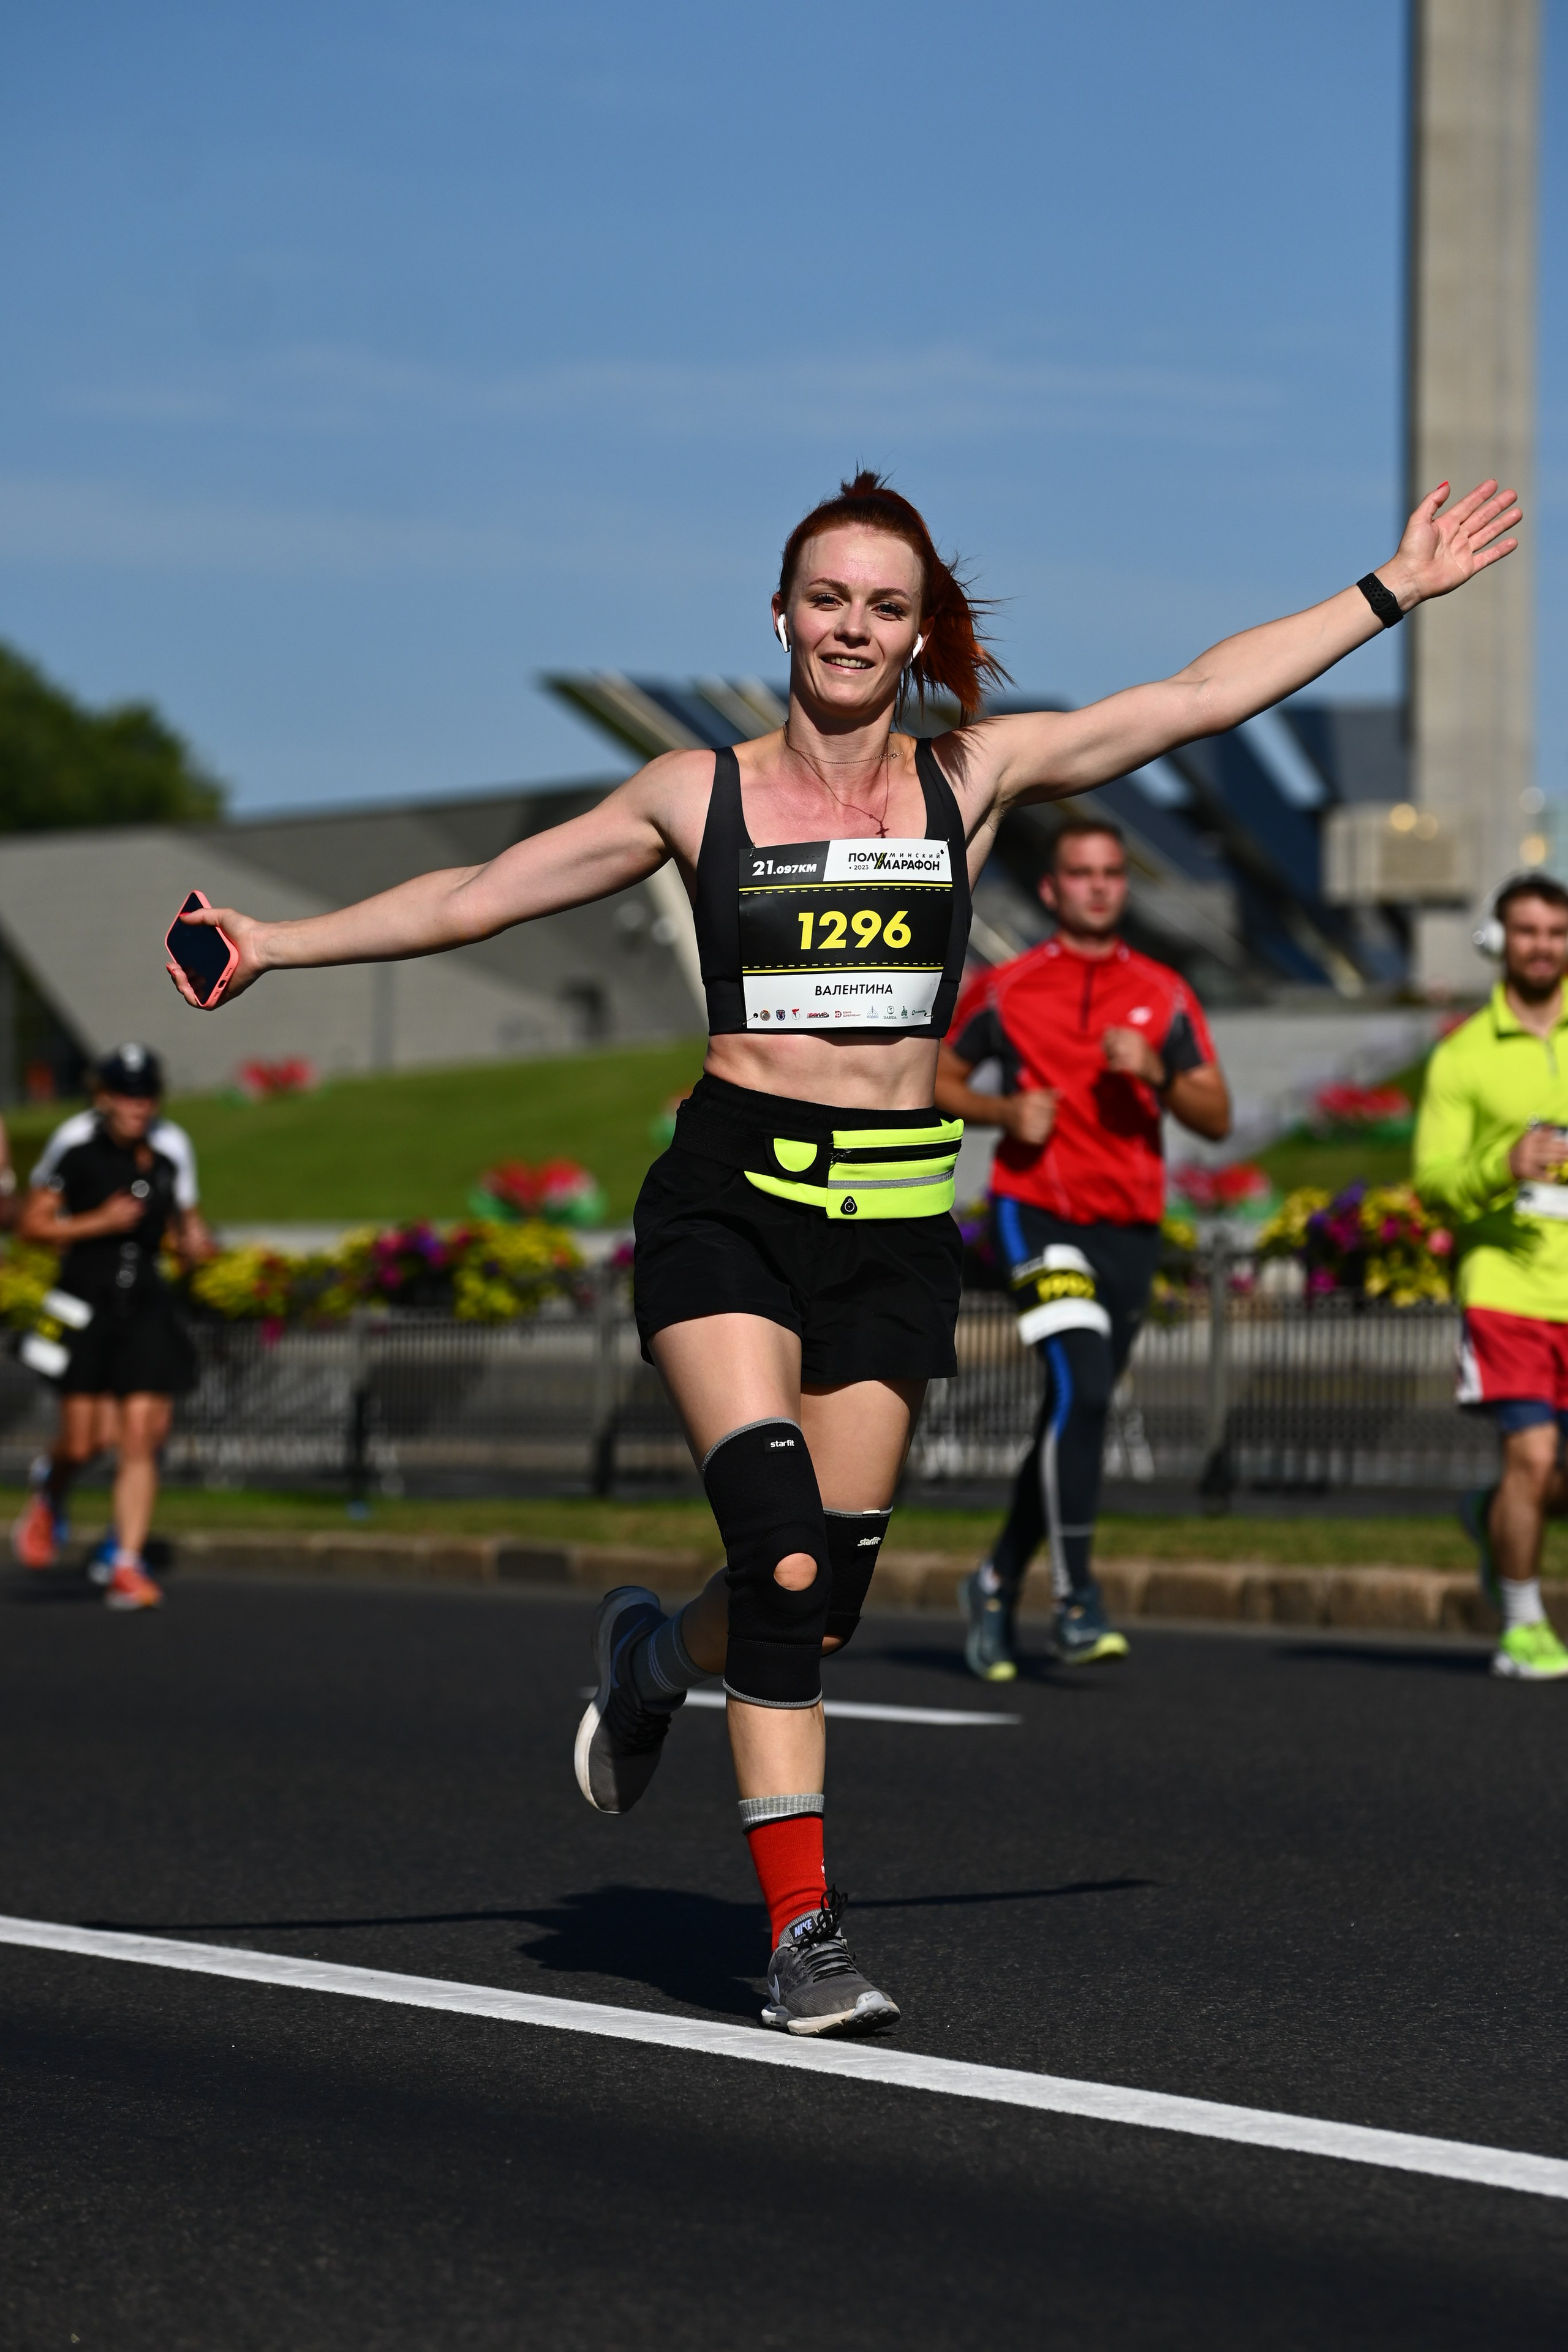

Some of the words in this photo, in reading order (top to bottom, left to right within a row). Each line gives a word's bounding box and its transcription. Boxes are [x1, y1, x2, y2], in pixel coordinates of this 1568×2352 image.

[877, 859, 940, 871] МАРАФОН
[798, 910, 911, 950] 1296
[815, 984, 893, 996] ВАЛЕНТИНА
[770, 1439, 795, 1448] starfit
[858, 1536, 881, 1547] starfit
[794, 1918, 813, 1938] NIKE
